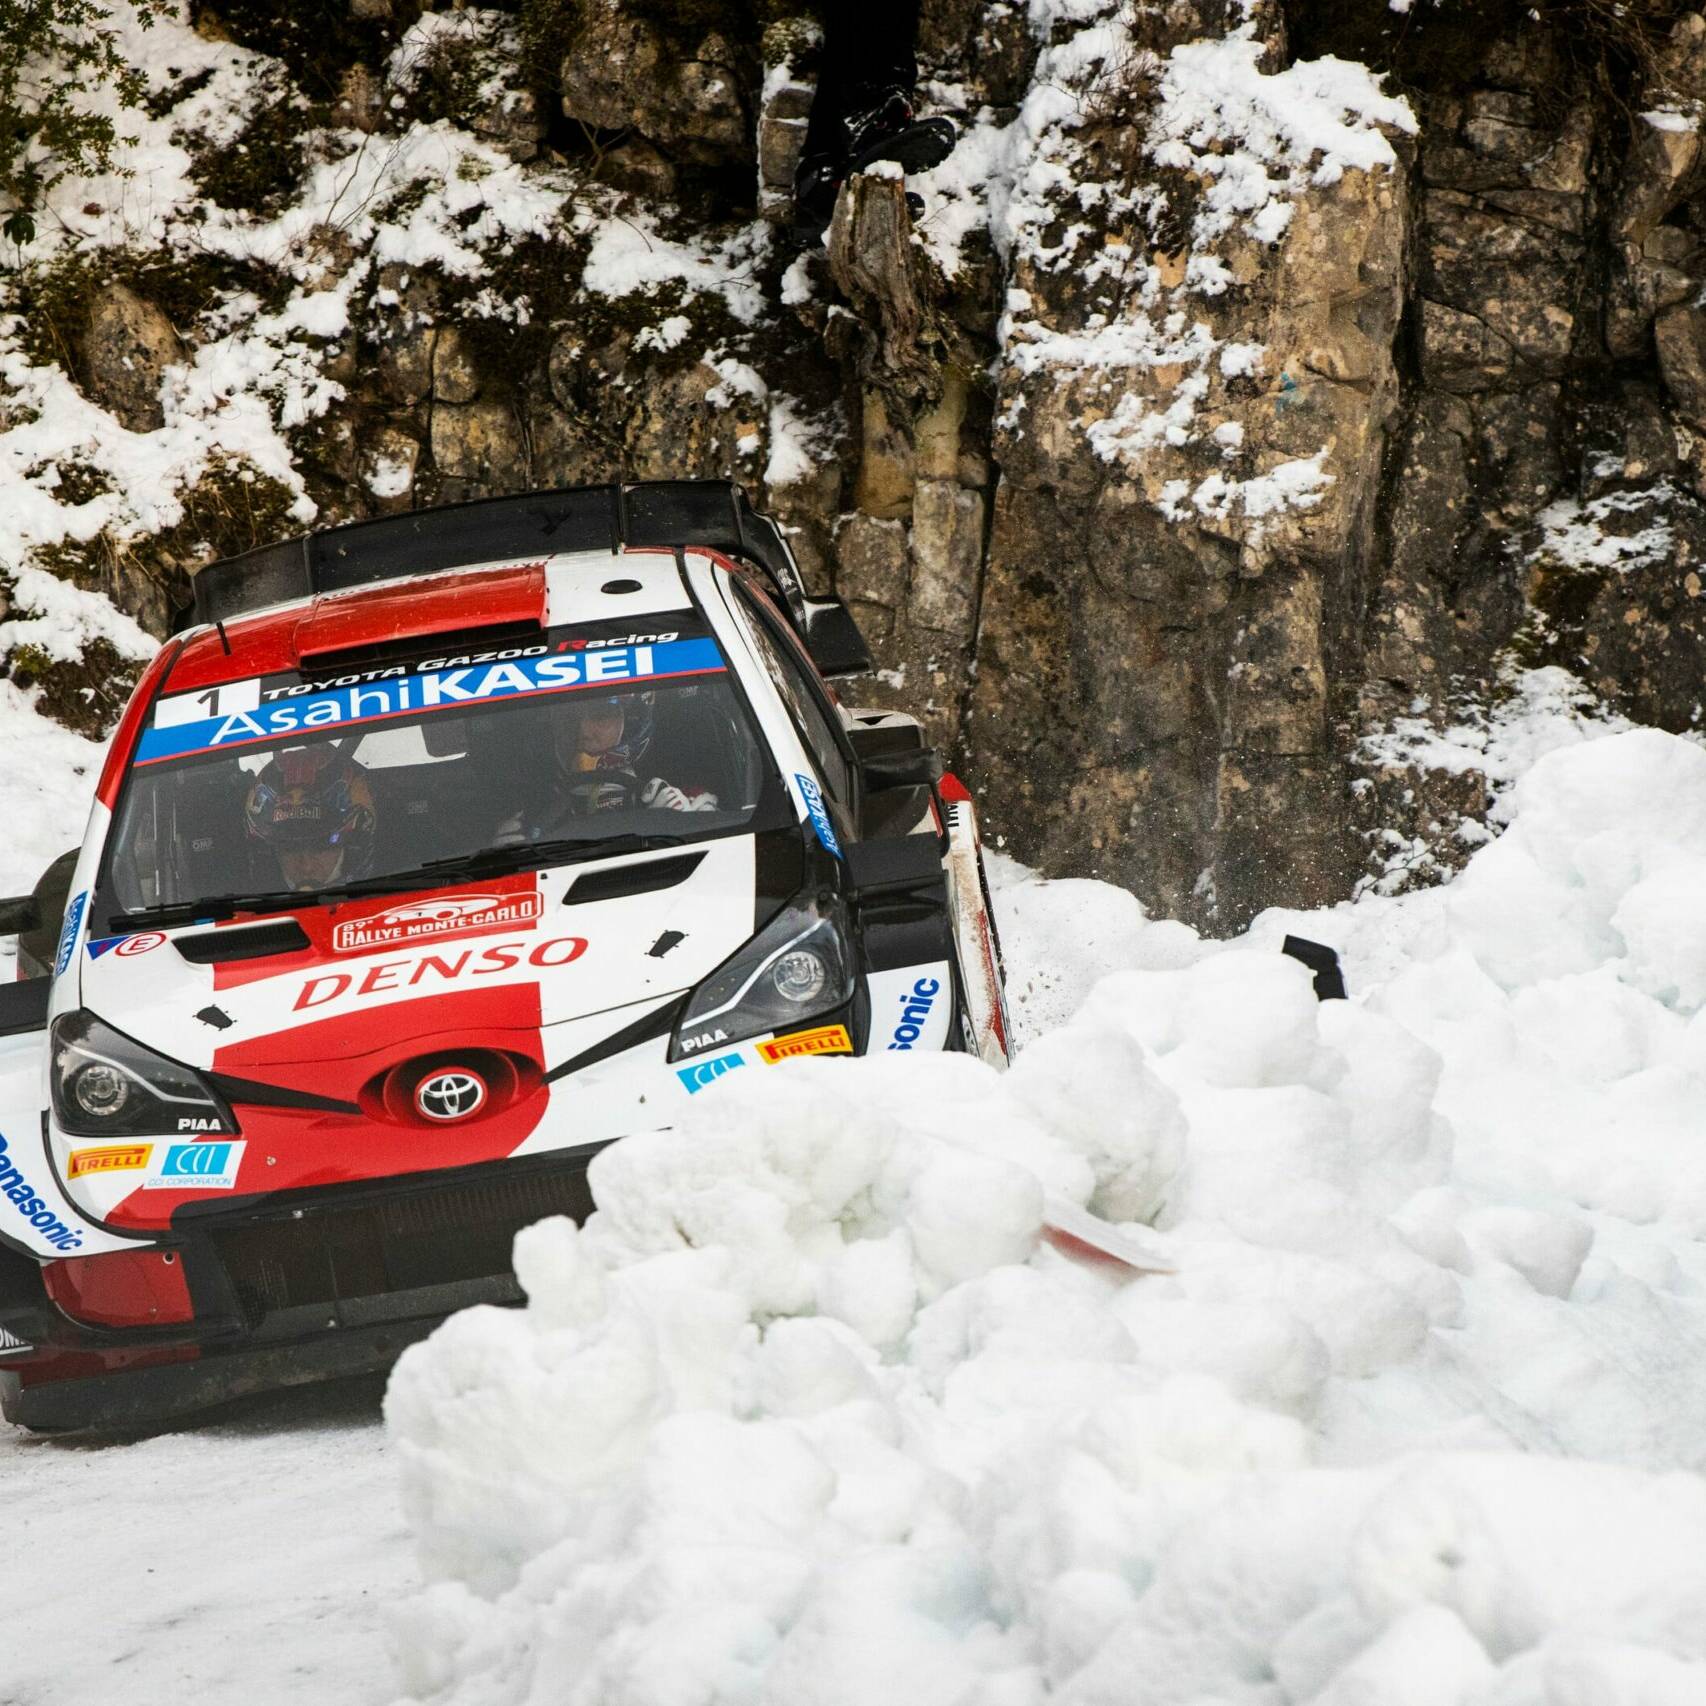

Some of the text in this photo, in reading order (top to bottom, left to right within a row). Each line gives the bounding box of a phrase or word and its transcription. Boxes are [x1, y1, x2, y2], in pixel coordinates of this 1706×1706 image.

[263, 631, 679, 700] TOYOTA GAZOO Racing
[197, 688, 220, 717] 1
[342, 901, 533, 948] RALLYE MONTE-CARLO
[128, 937, 154, 951] E
[292, 937, 589, 1012] DENSO
[681, 1029, 728, 1052] PIAA
[764, 1030, 845, 1060] PIRELLI
[178, 1118, 222, 1131] PIAA
[72, 1148, 146, 1174] PIRELLI
[176, 1146, 216, 1174] CCI
[166, 1176, 232, 1187] CORPORATION
